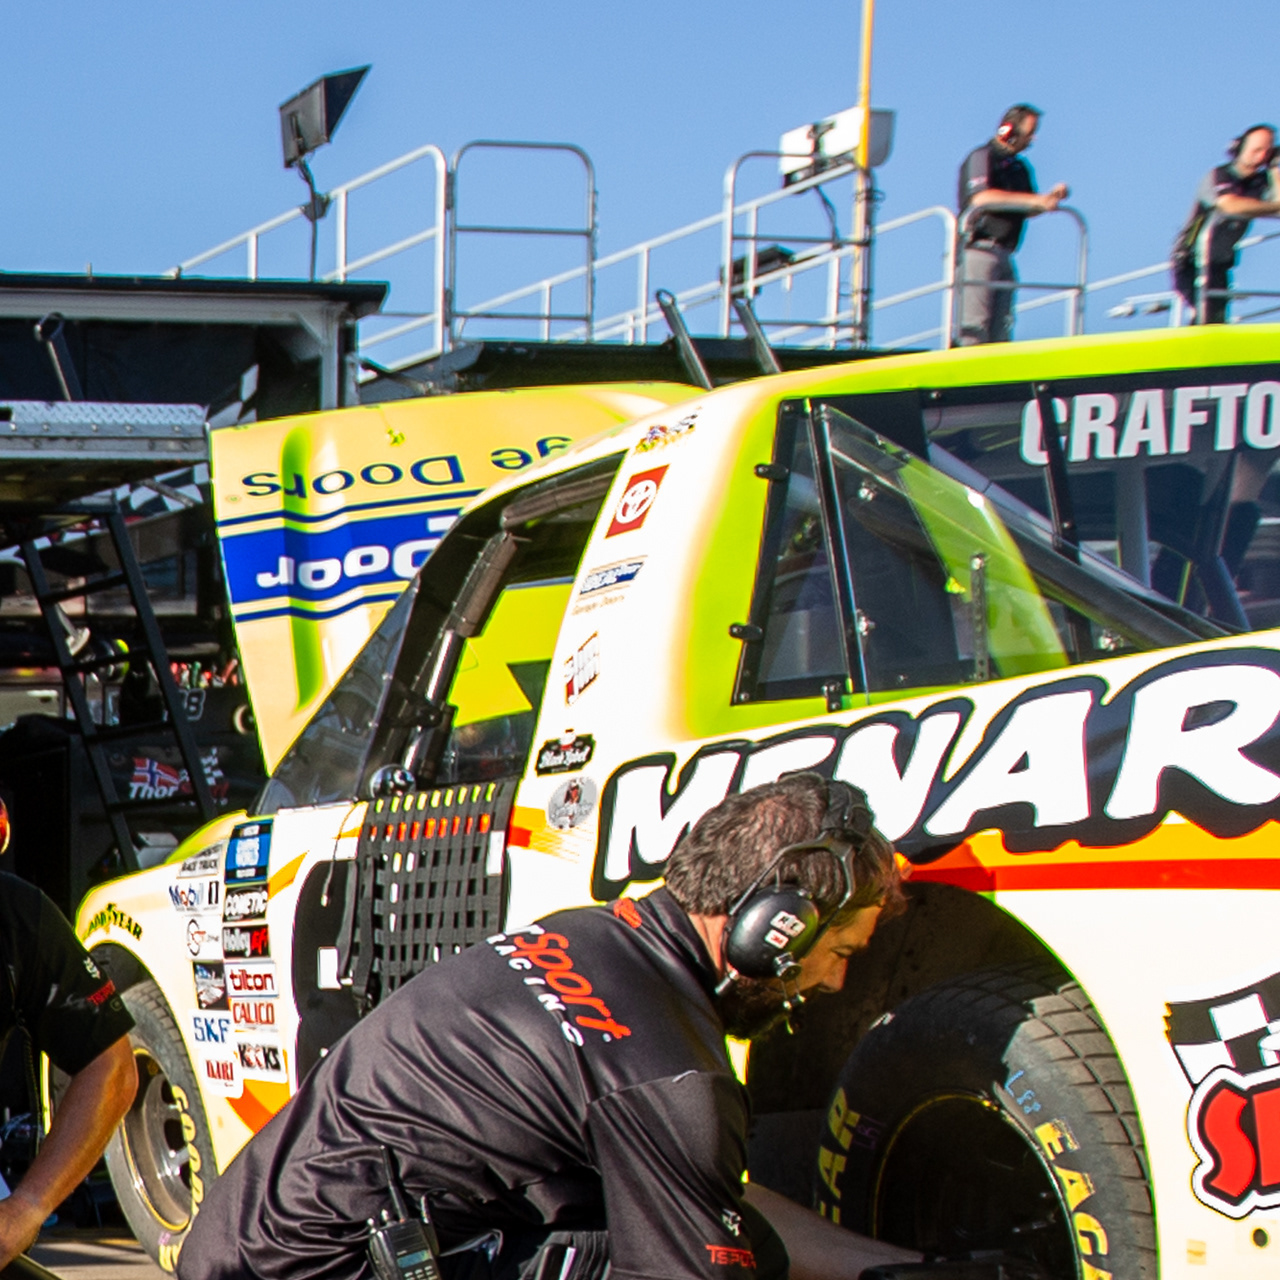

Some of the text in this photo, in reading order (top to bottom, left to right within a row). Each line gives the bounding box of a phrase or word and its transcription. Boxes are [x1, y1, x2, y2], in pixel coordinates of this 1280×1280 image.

[241, 454, 466, 500] Doors
[600, 660, 1280, 884] MNAR
[168, 882, 204, 908] Mobil
[228, 968, 275, 992] tilton
[232, 1002, 276, 1025] CALICO
[192, 1016, 232, 1044] SKF
